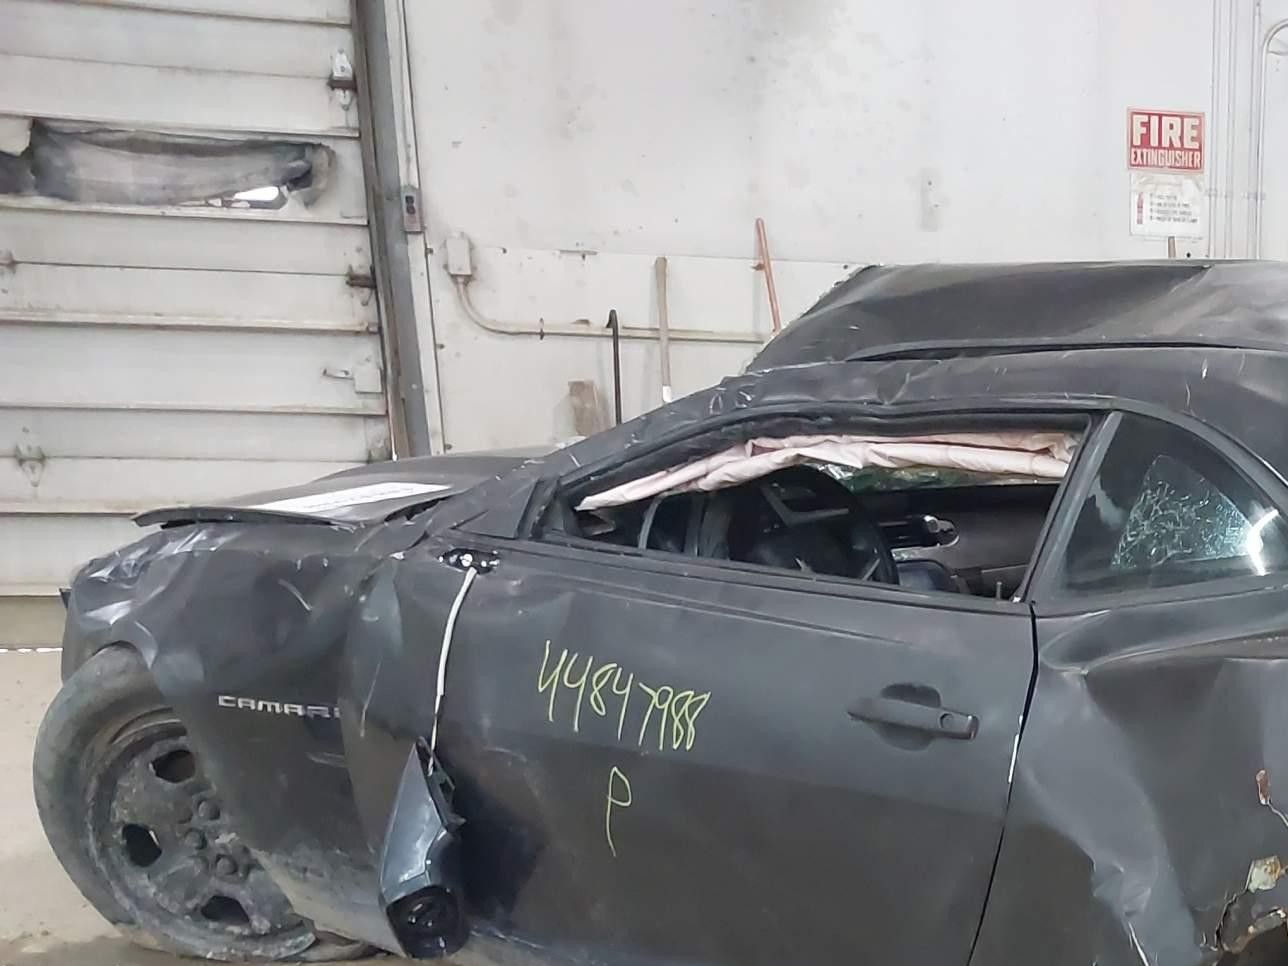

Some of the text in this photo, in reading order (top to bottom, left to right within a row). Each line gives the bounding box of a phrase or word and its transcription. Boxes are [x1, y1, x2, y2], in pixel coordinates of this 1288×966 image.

[1132, 114, 1200, 149] FIRE
[1131, 147, 1201, 168] EXTINGUISHER
[218, 695, 340, 718] CAMAR
[538, 639, 711, 751] 44847988
[606, 766, 632, 857] P
